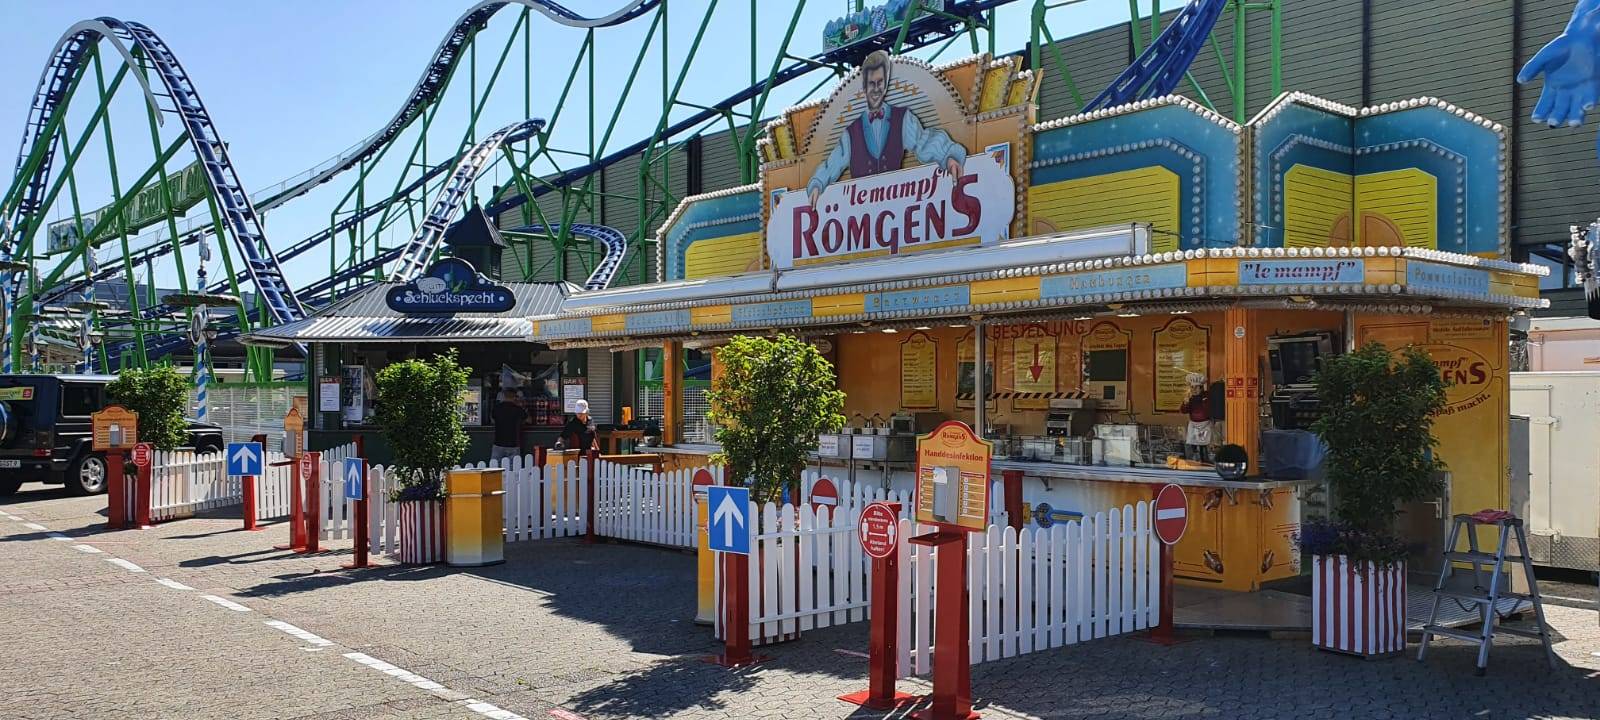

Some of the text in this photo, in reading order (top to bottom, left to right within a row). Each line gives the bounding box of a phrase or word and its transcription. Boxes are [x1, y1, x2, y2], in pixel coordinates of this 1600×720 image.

[403, 290, 496, 306] Schluckspecht
[1456, 393, 1492, 412] macht.
[924, 448, 984, 462] Handdesinfektion
